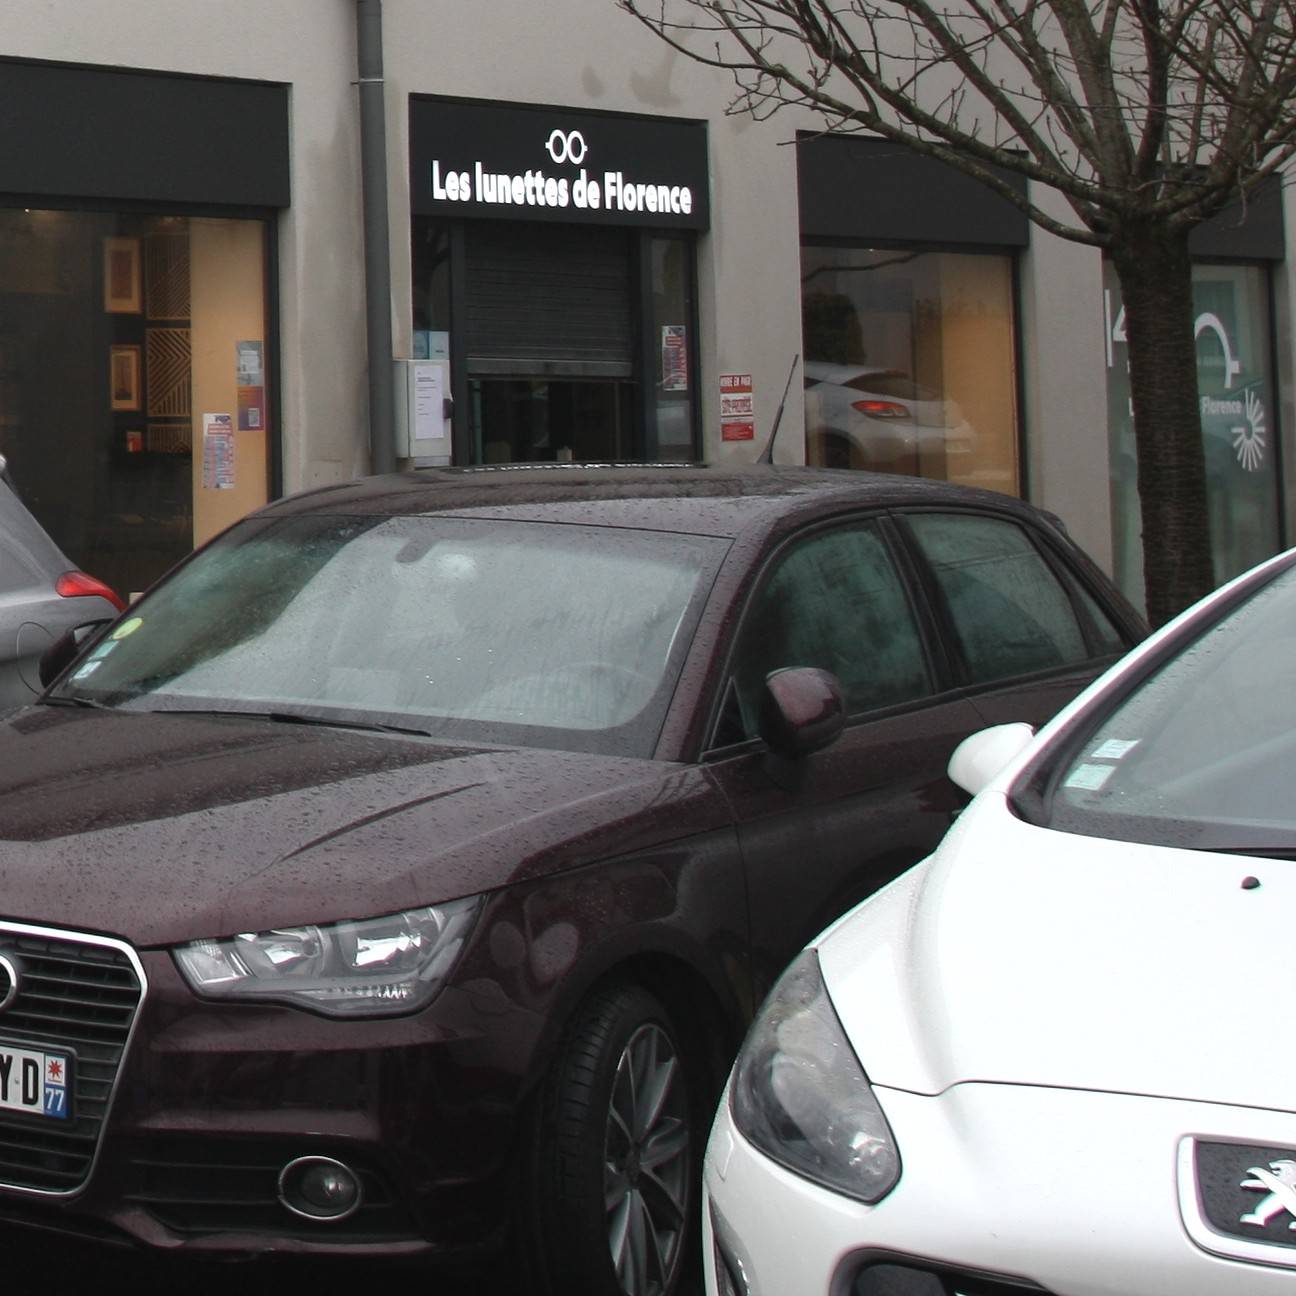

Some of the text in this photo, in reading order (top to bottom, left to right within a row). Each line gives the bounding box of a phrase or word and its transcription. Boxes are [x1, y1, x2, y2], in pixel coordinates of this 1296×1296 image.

[432, 159, 692, 215] Les lunettes de Florence
[1201, 395, 1243, 418] Florence
[45, 1087, 65, 1112] 77
